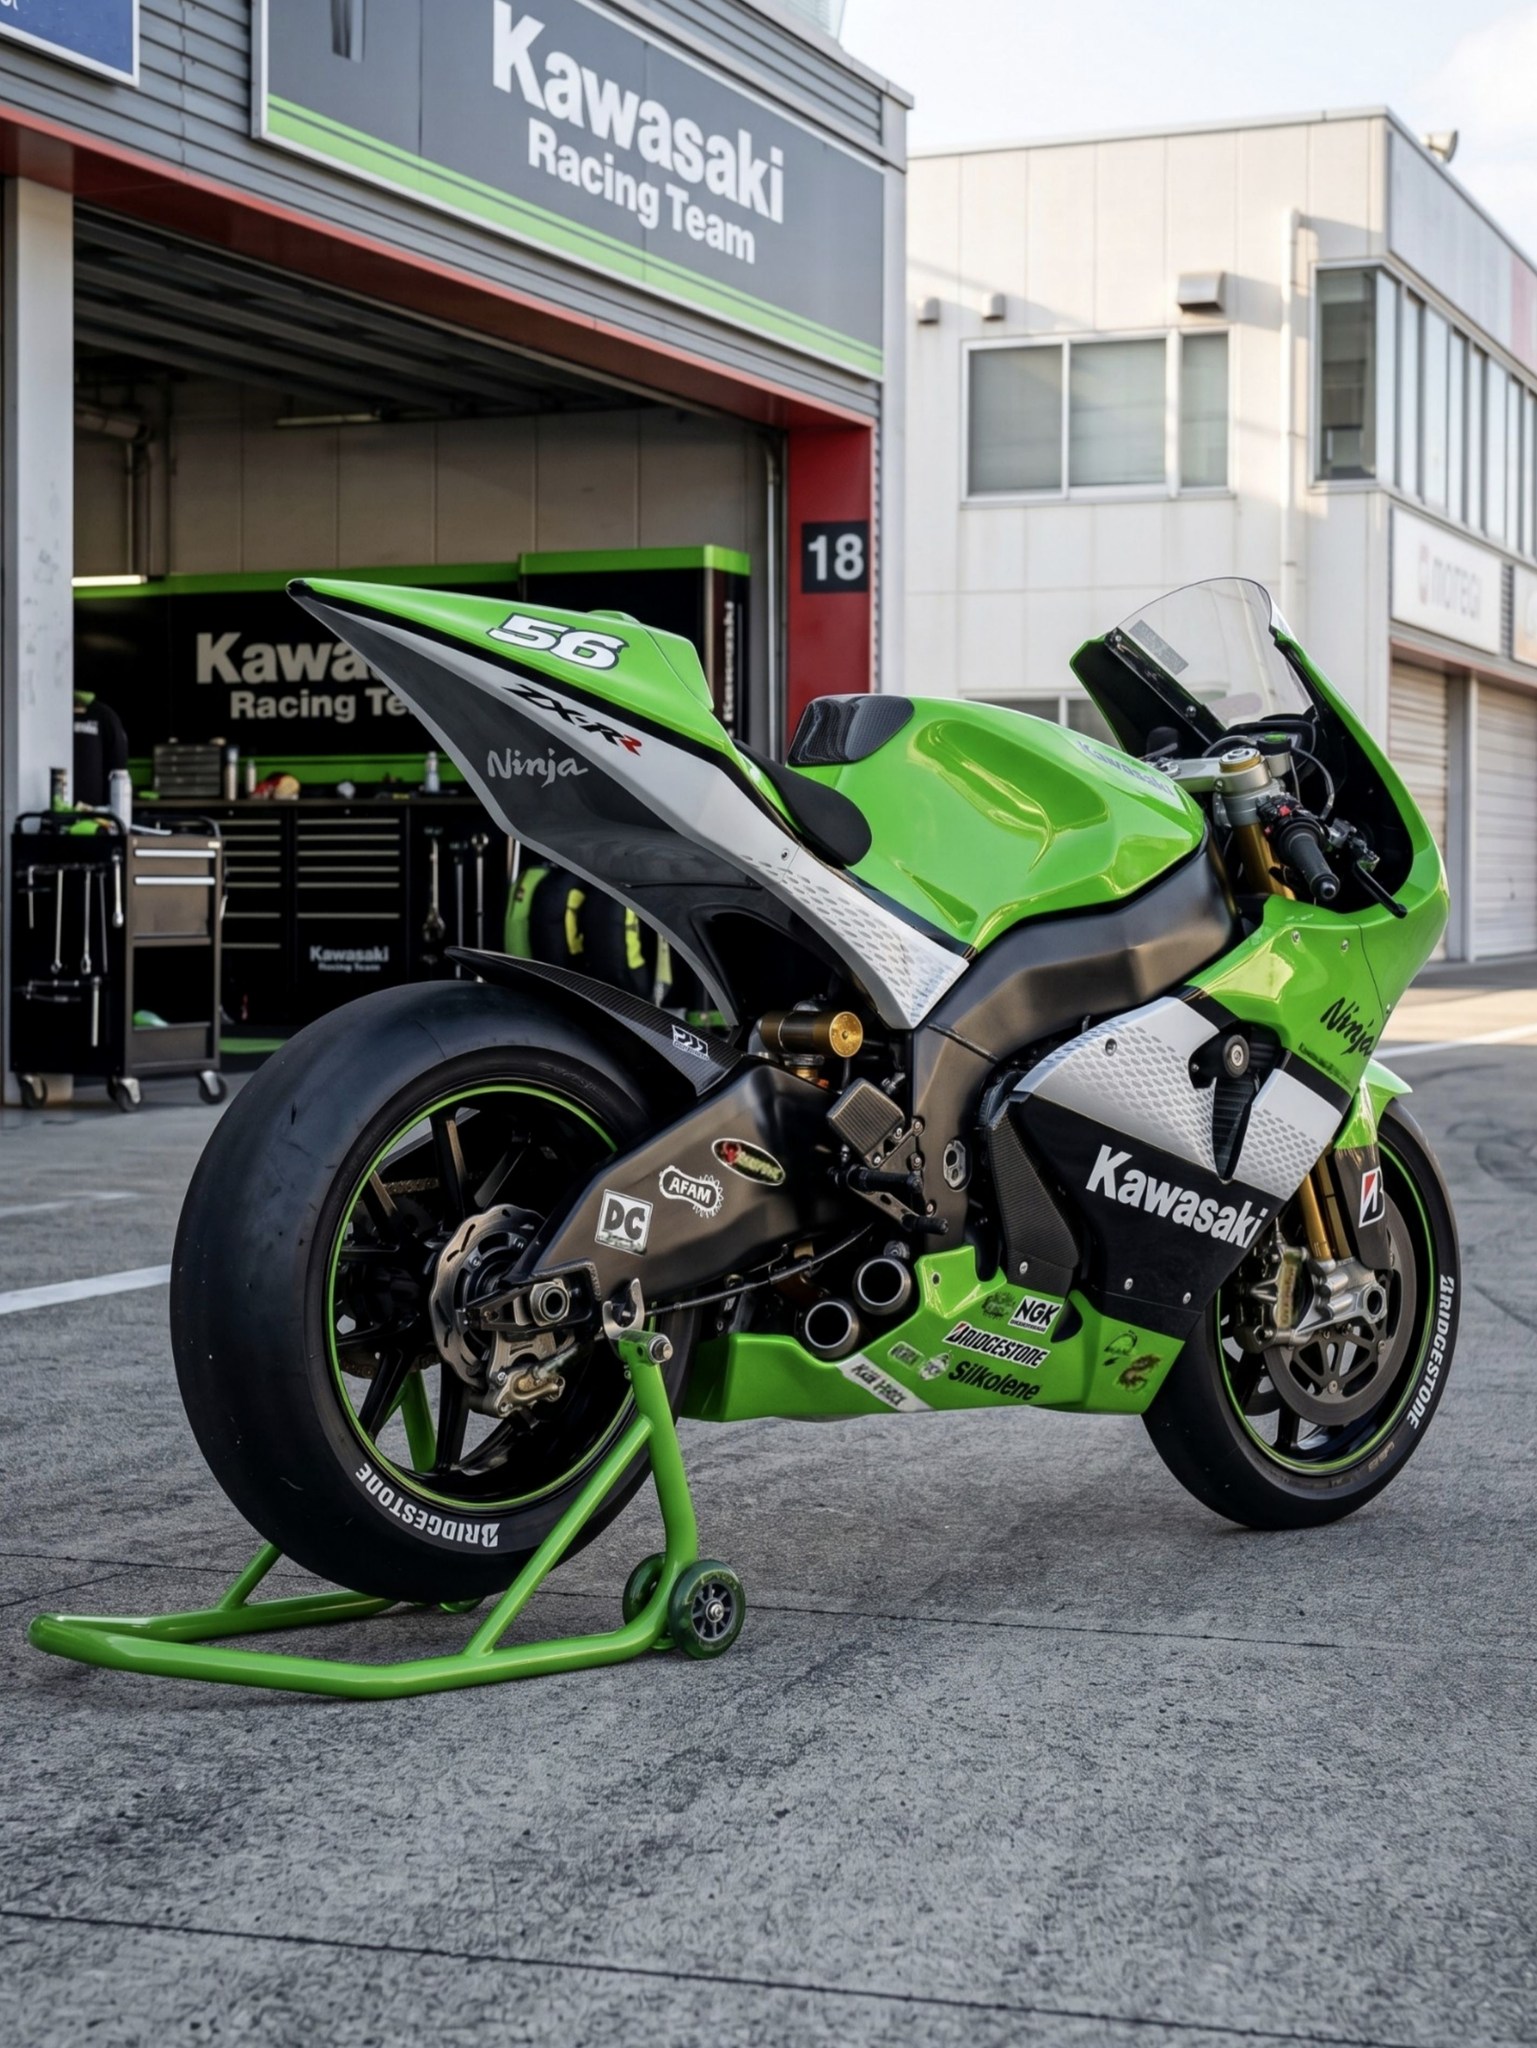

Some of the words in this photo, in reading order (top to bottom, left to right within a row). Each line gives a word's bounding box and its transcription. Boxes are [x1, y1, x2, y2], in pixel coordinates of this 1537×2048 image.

[493, 0, 783, 224] Kawasaki
[528, 117, 660, 229] Racing
[665, 182, 755, 264] Team
[808, 533, 864, 581] 18
[196, 632, 382, 684] Kawa
[486, 612, 630, 671] 56
[230, 689, 356, 722] Racing
[365, 687, 414, 717] Te
[487, 747, 589, 788] Ninja
[310, 944, 389, 962] Kawasaki
[1320, 996, 1375, 1057] Ninja
[668, 1176, 712, 1204] AFAM
[1085, 1144, 1269, 1248] Kawasaki
[604, 1198, 645, 1241] DC
[1014, 1298, 1061, 1327] NGK
[945, 1322, 1049, 1368] BRIDGESTONE
[1406, 1274, 1455, 1429] BRIDGESTONE
[948, 1360, 1042, 1401] Silkolene
[355, 1463, 500, 1547] BRIDGESTONE
